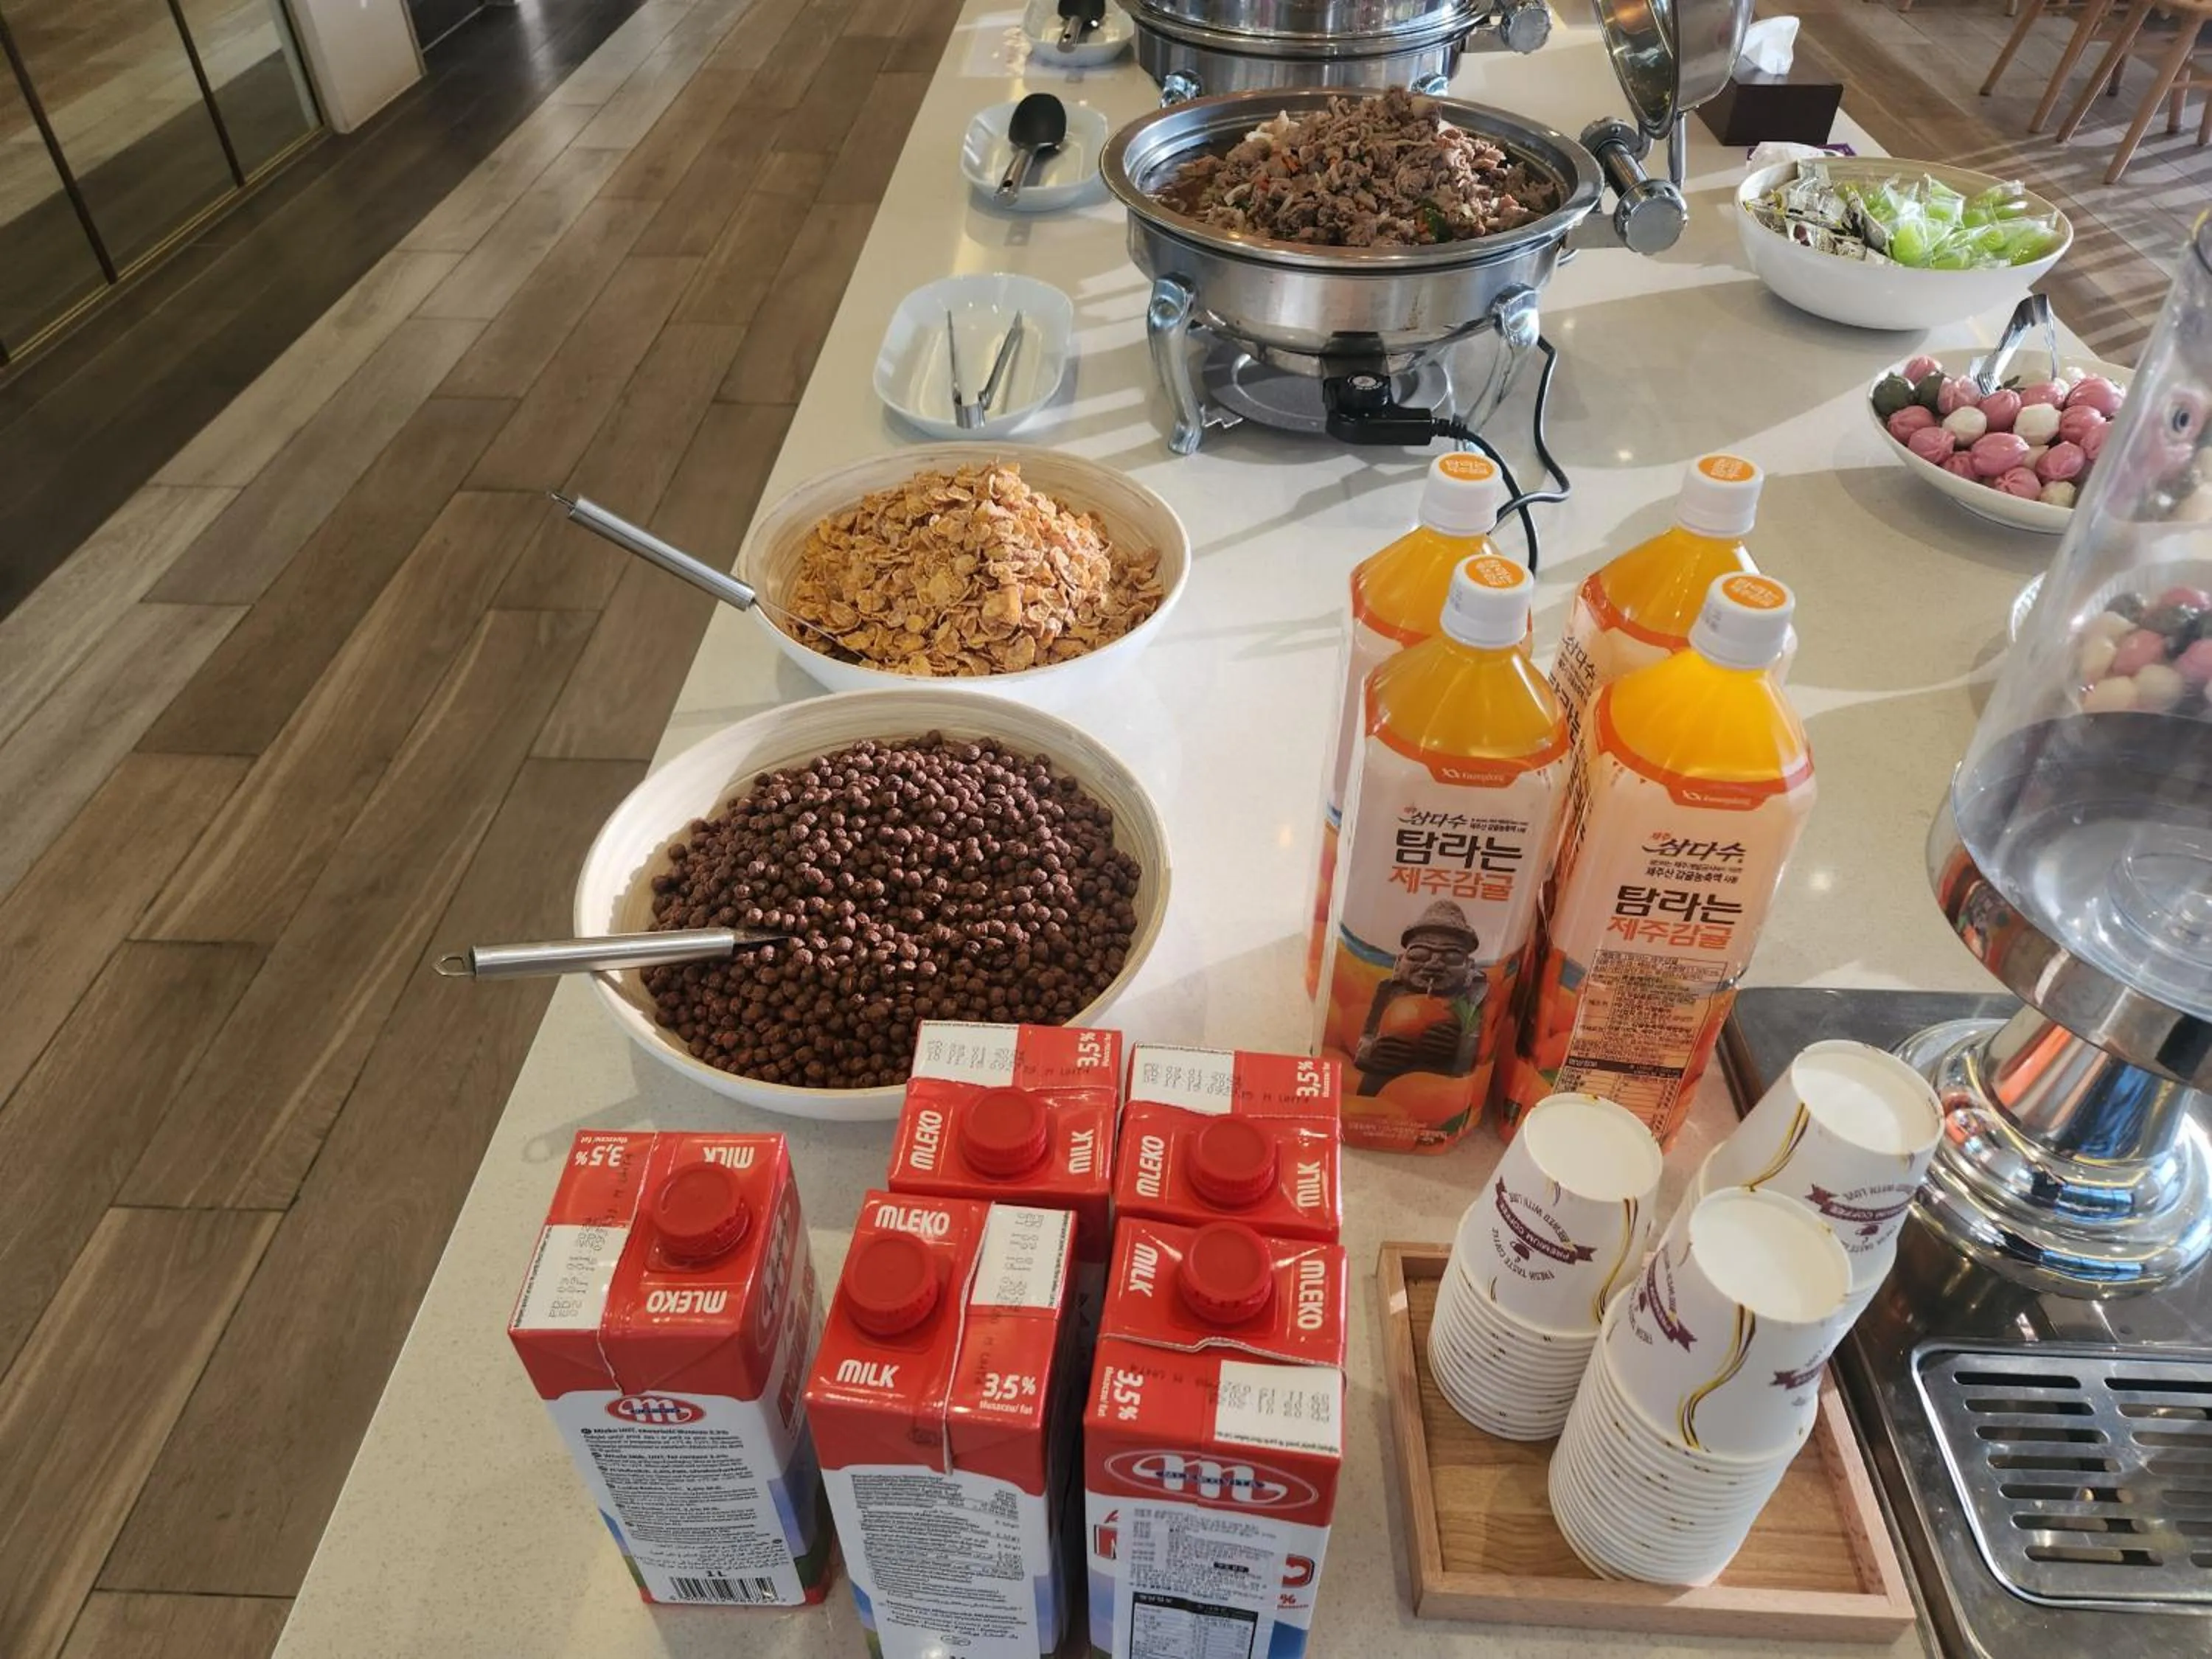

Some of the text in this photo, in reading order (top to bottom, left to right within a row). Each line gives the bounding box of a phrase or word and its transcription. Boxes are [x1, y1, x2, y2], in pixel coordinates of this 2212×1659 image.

[1396, 829, 1523, 872] 탐라는
[1655, 838, 1747, 863] 삼다수
[1388, 866, 1516, 902] 제주감귤
[1615, 885, 1743, 925] 탐라는
[1606, 916, 1733, 950] 제주감귤
[703, 1146, 754, 1169] MILK
[910, 1109, 943, 1170] MLEKO
[1068, 1129, 1095, 1174] MILK
[1136, 1135, 1165, 1198] MLEKO
[1296, 1161, 1321, 1208] MILK
[875, 1205, 950, 1236] MLEKO
[1129, 1243, 1158, 1298] MILK
[646, 1290, 728, 1313] MLEKO
[1298, 1259, 1325, 1330] MLEKO
[836, 1359, 900, 1389] MILK
